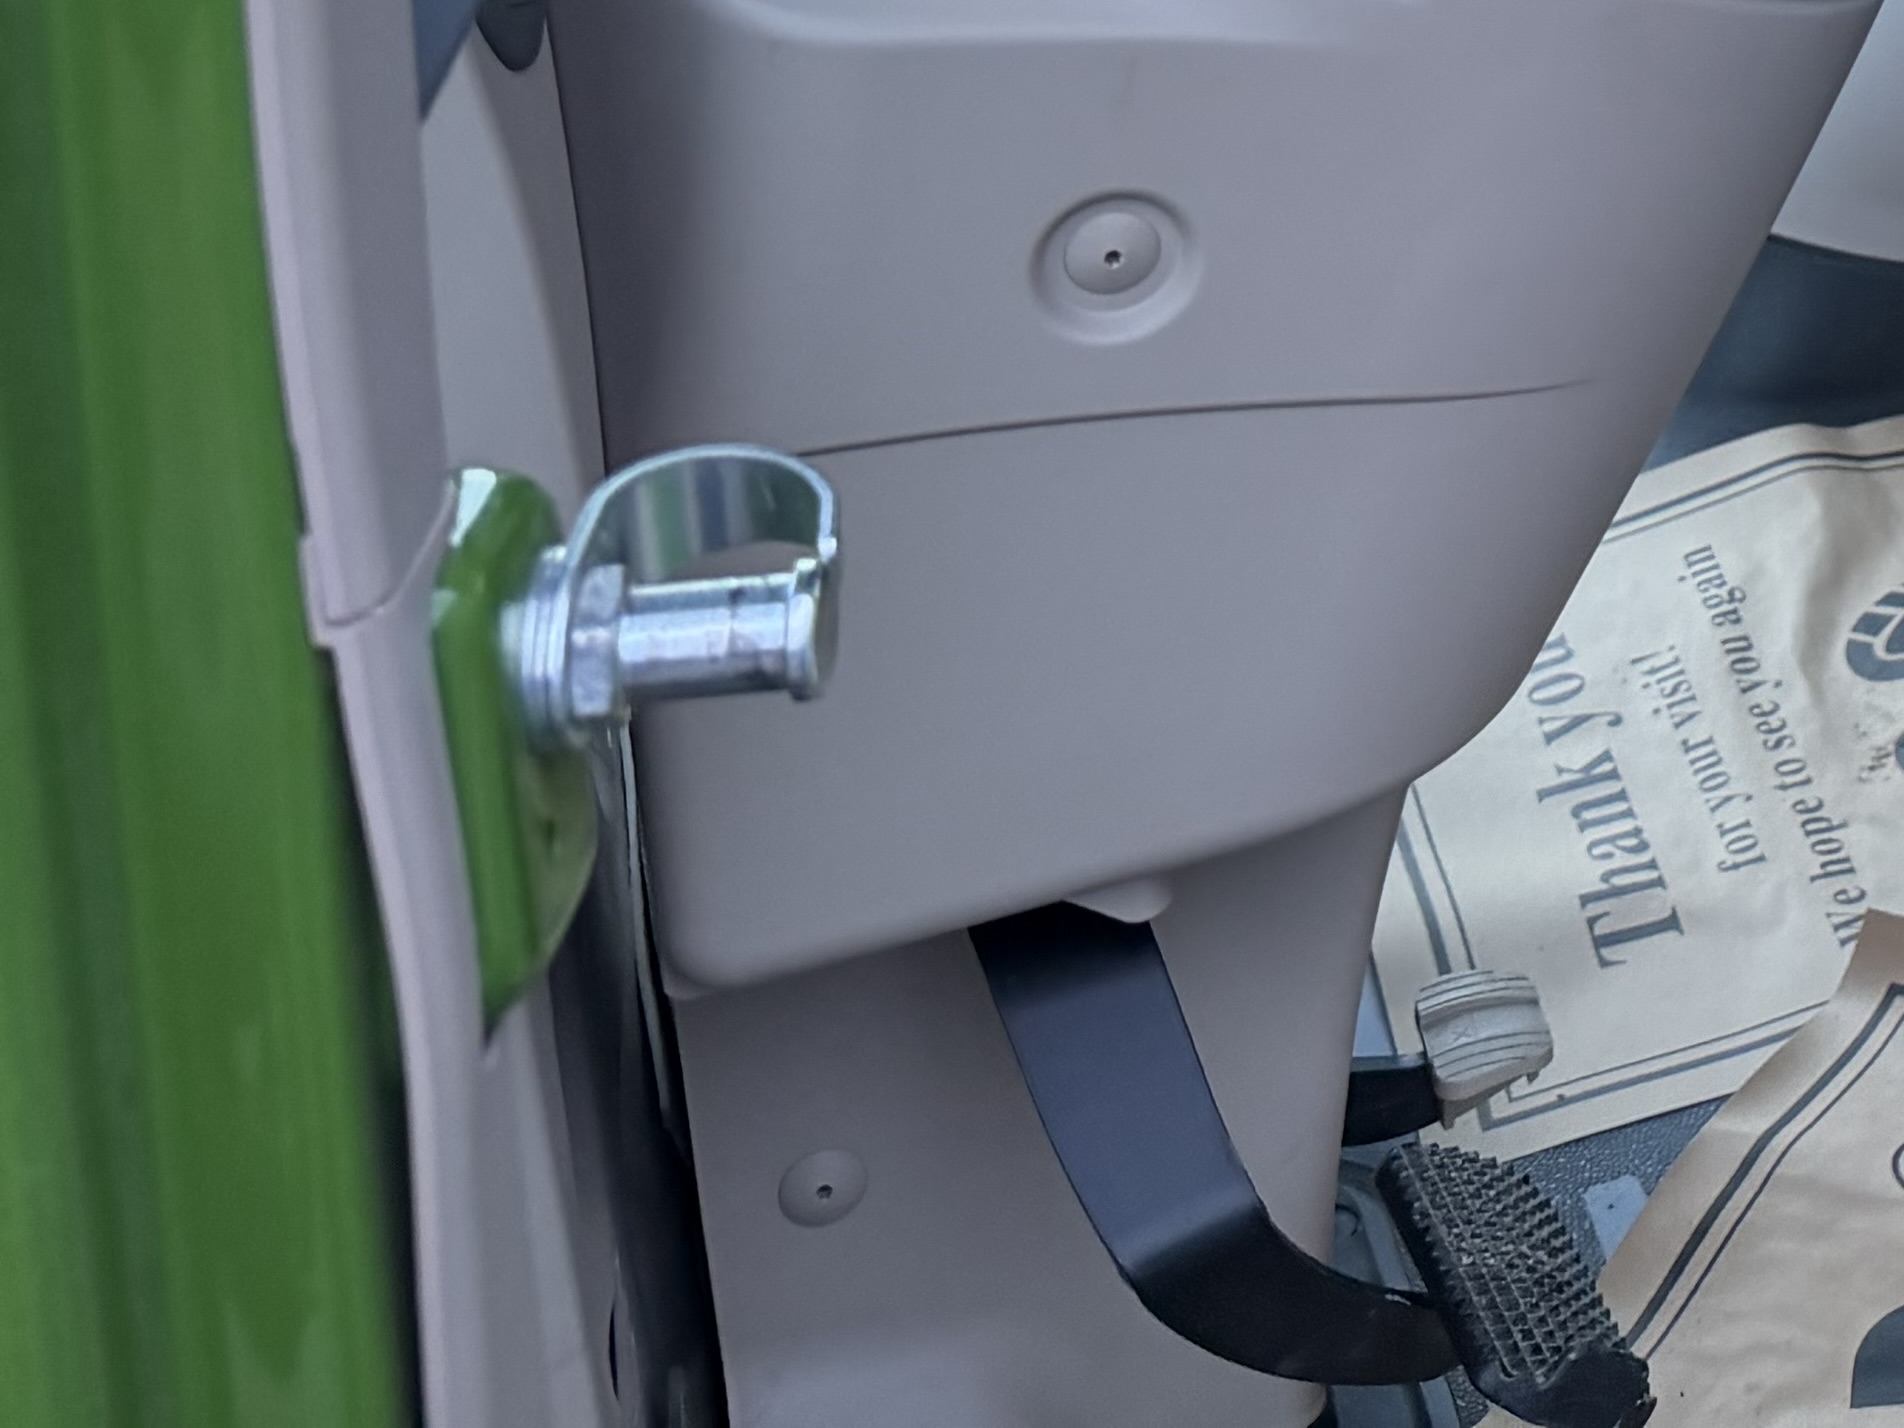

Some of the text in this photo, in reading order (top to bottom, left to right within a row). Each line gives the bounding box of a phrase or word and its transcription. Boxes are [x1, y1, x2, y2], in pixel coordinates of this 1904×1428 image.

[1677, 543, 1747, 628] again
[1721, 634, 1782, 694] you
[1629, 644, 1767, 873] for your visit!
[1748, 703, 1796, 751] see
[1527, 632, 1684, 969] Thank you
[1773, 758, 1812, 792] to
[1791, 796, 1857, 883] hope
